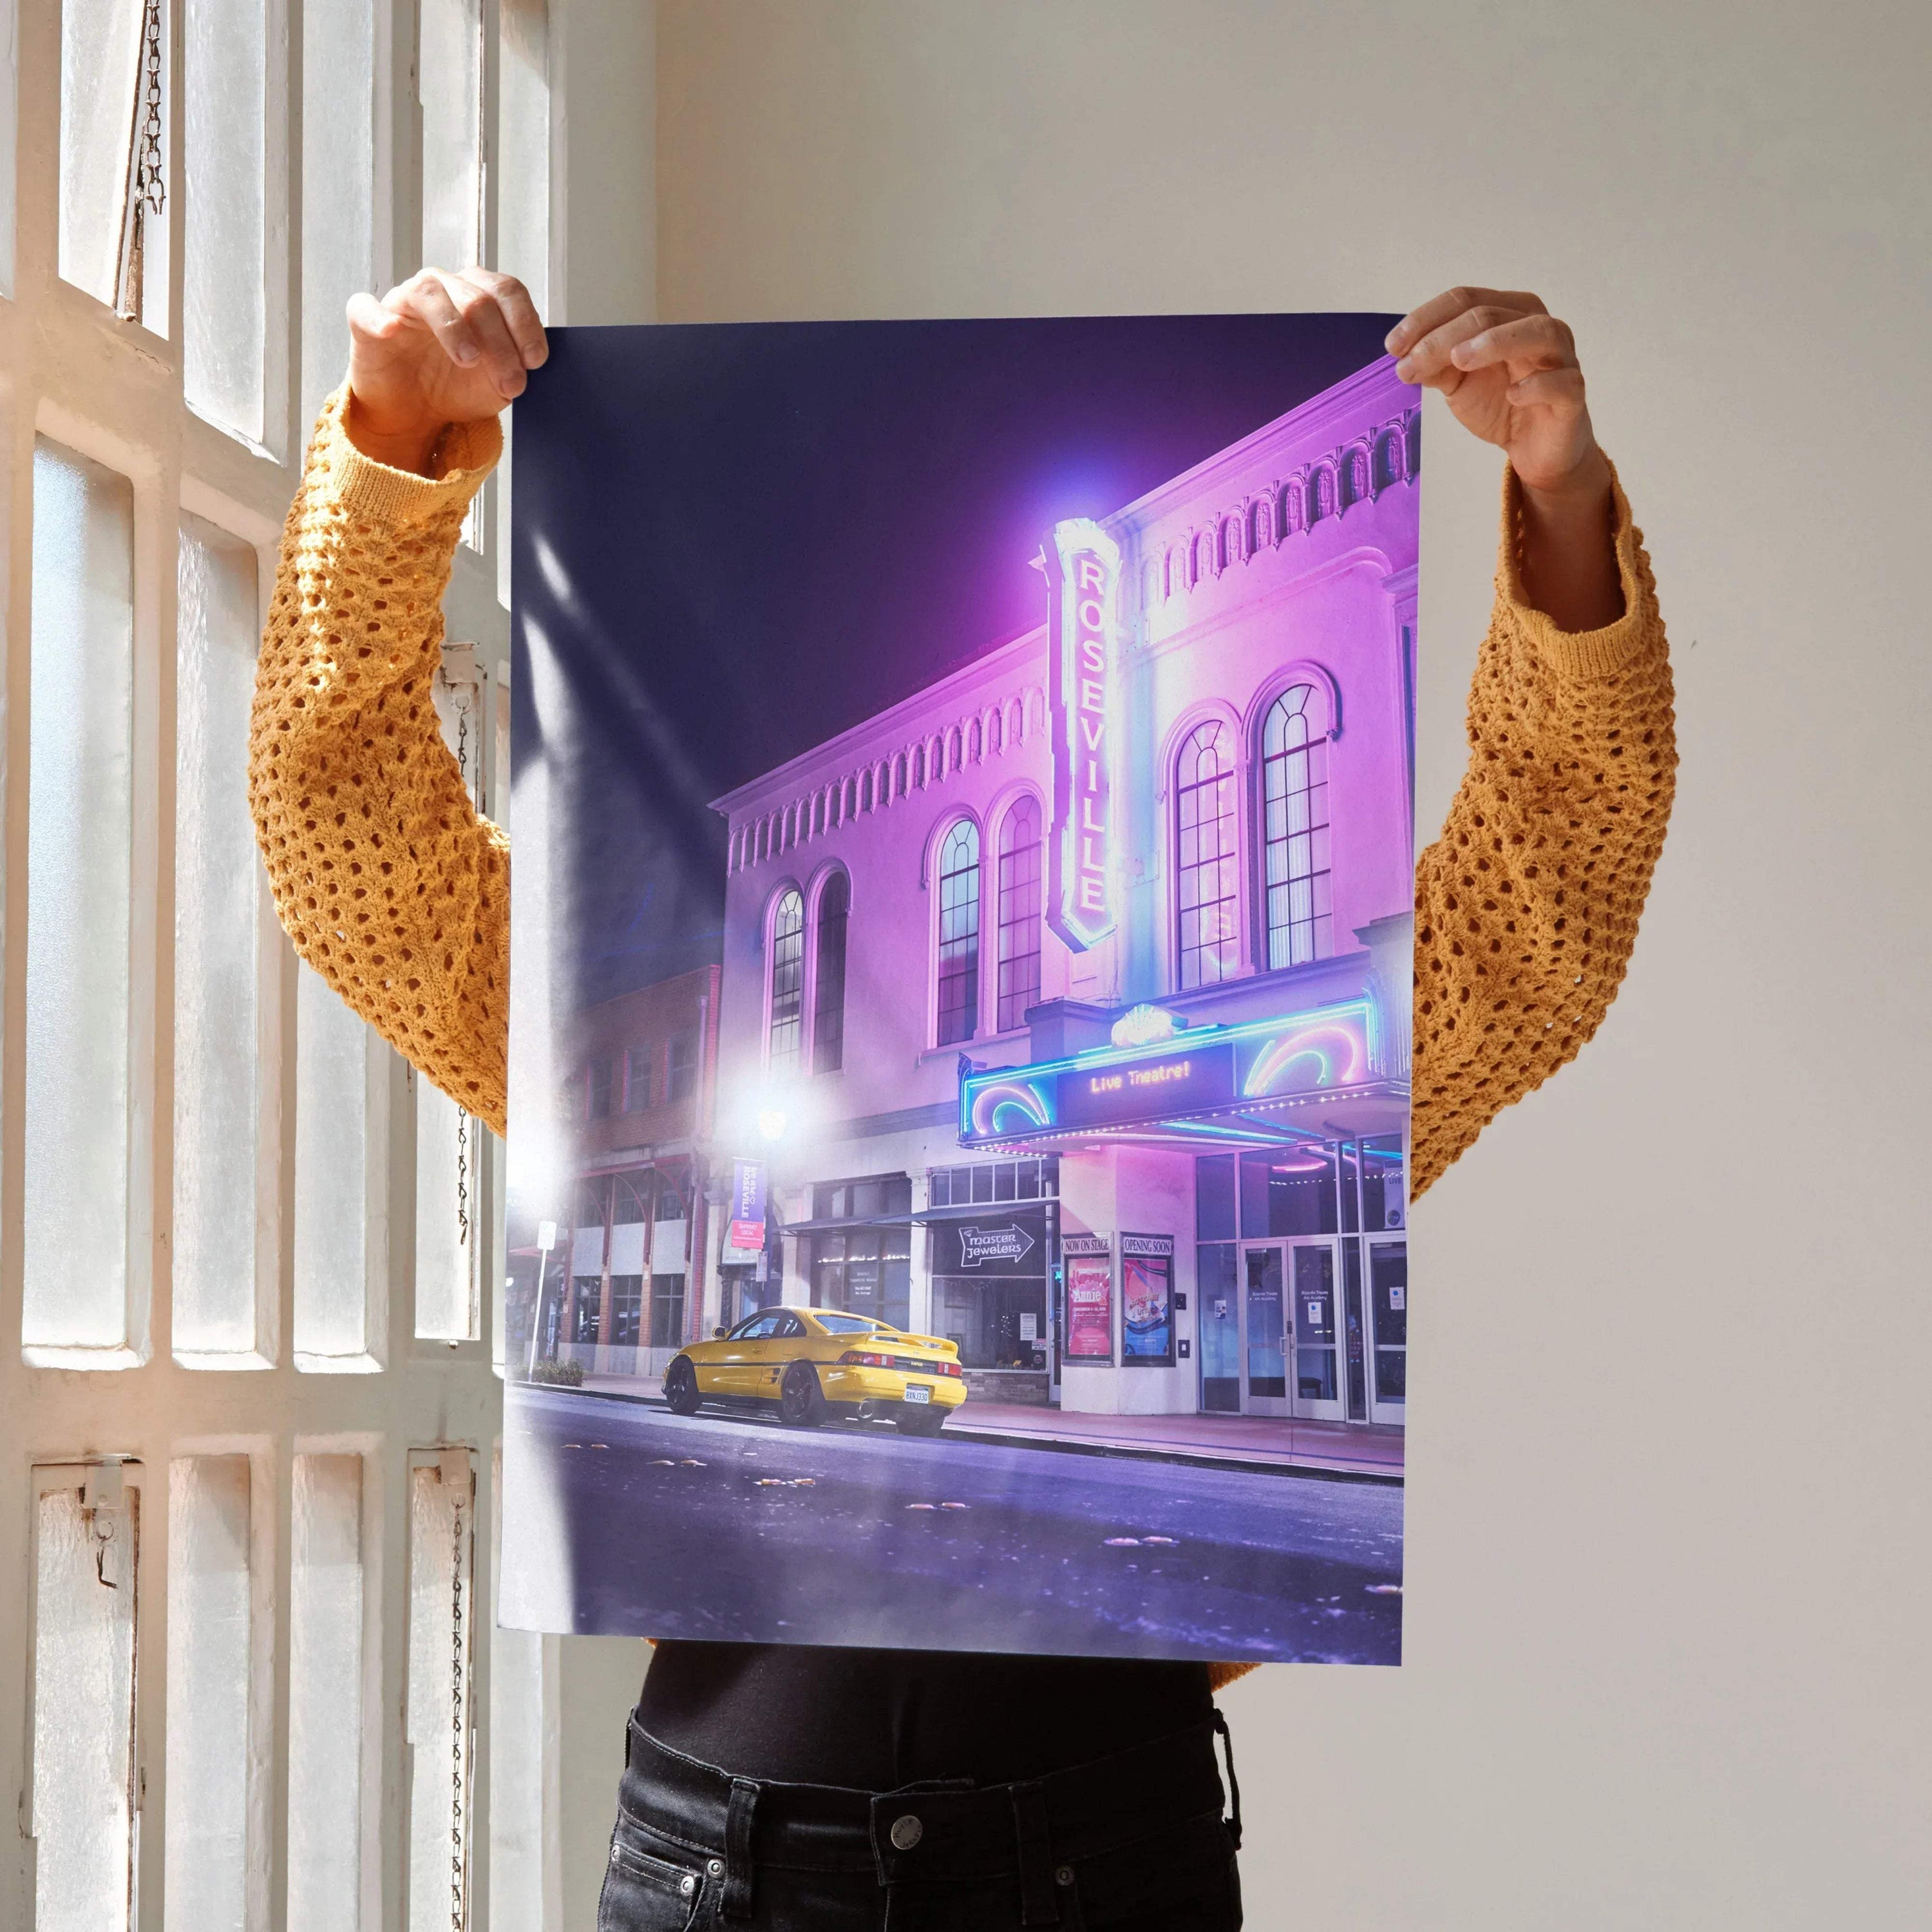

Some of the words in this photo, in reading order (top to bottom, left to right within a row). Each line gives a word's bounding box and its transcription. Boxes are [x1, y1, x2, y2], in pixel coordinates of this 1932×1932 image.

[1079, 560, 1106, 912] ROSEVILLE
[1090, 1076, 1122, 1094] Live
[1128, 1061, 1190, 1086] Theatre!
[741, 1166, 751, 1218] ROSEVILLE
[1066, 1240, 1080, 1251] NOW
[1081, 1240, 1090, 1251] ON
[1091, 1238, 1109, 1251] STAGE
[1124, 1238, 1152, 1252] OPENING
[1153, 1241, 1170, 1253] SOON
[1074, 1289, 1102, 1302] Annie
[906, 1391, 927, 1401] 8XNJ330
